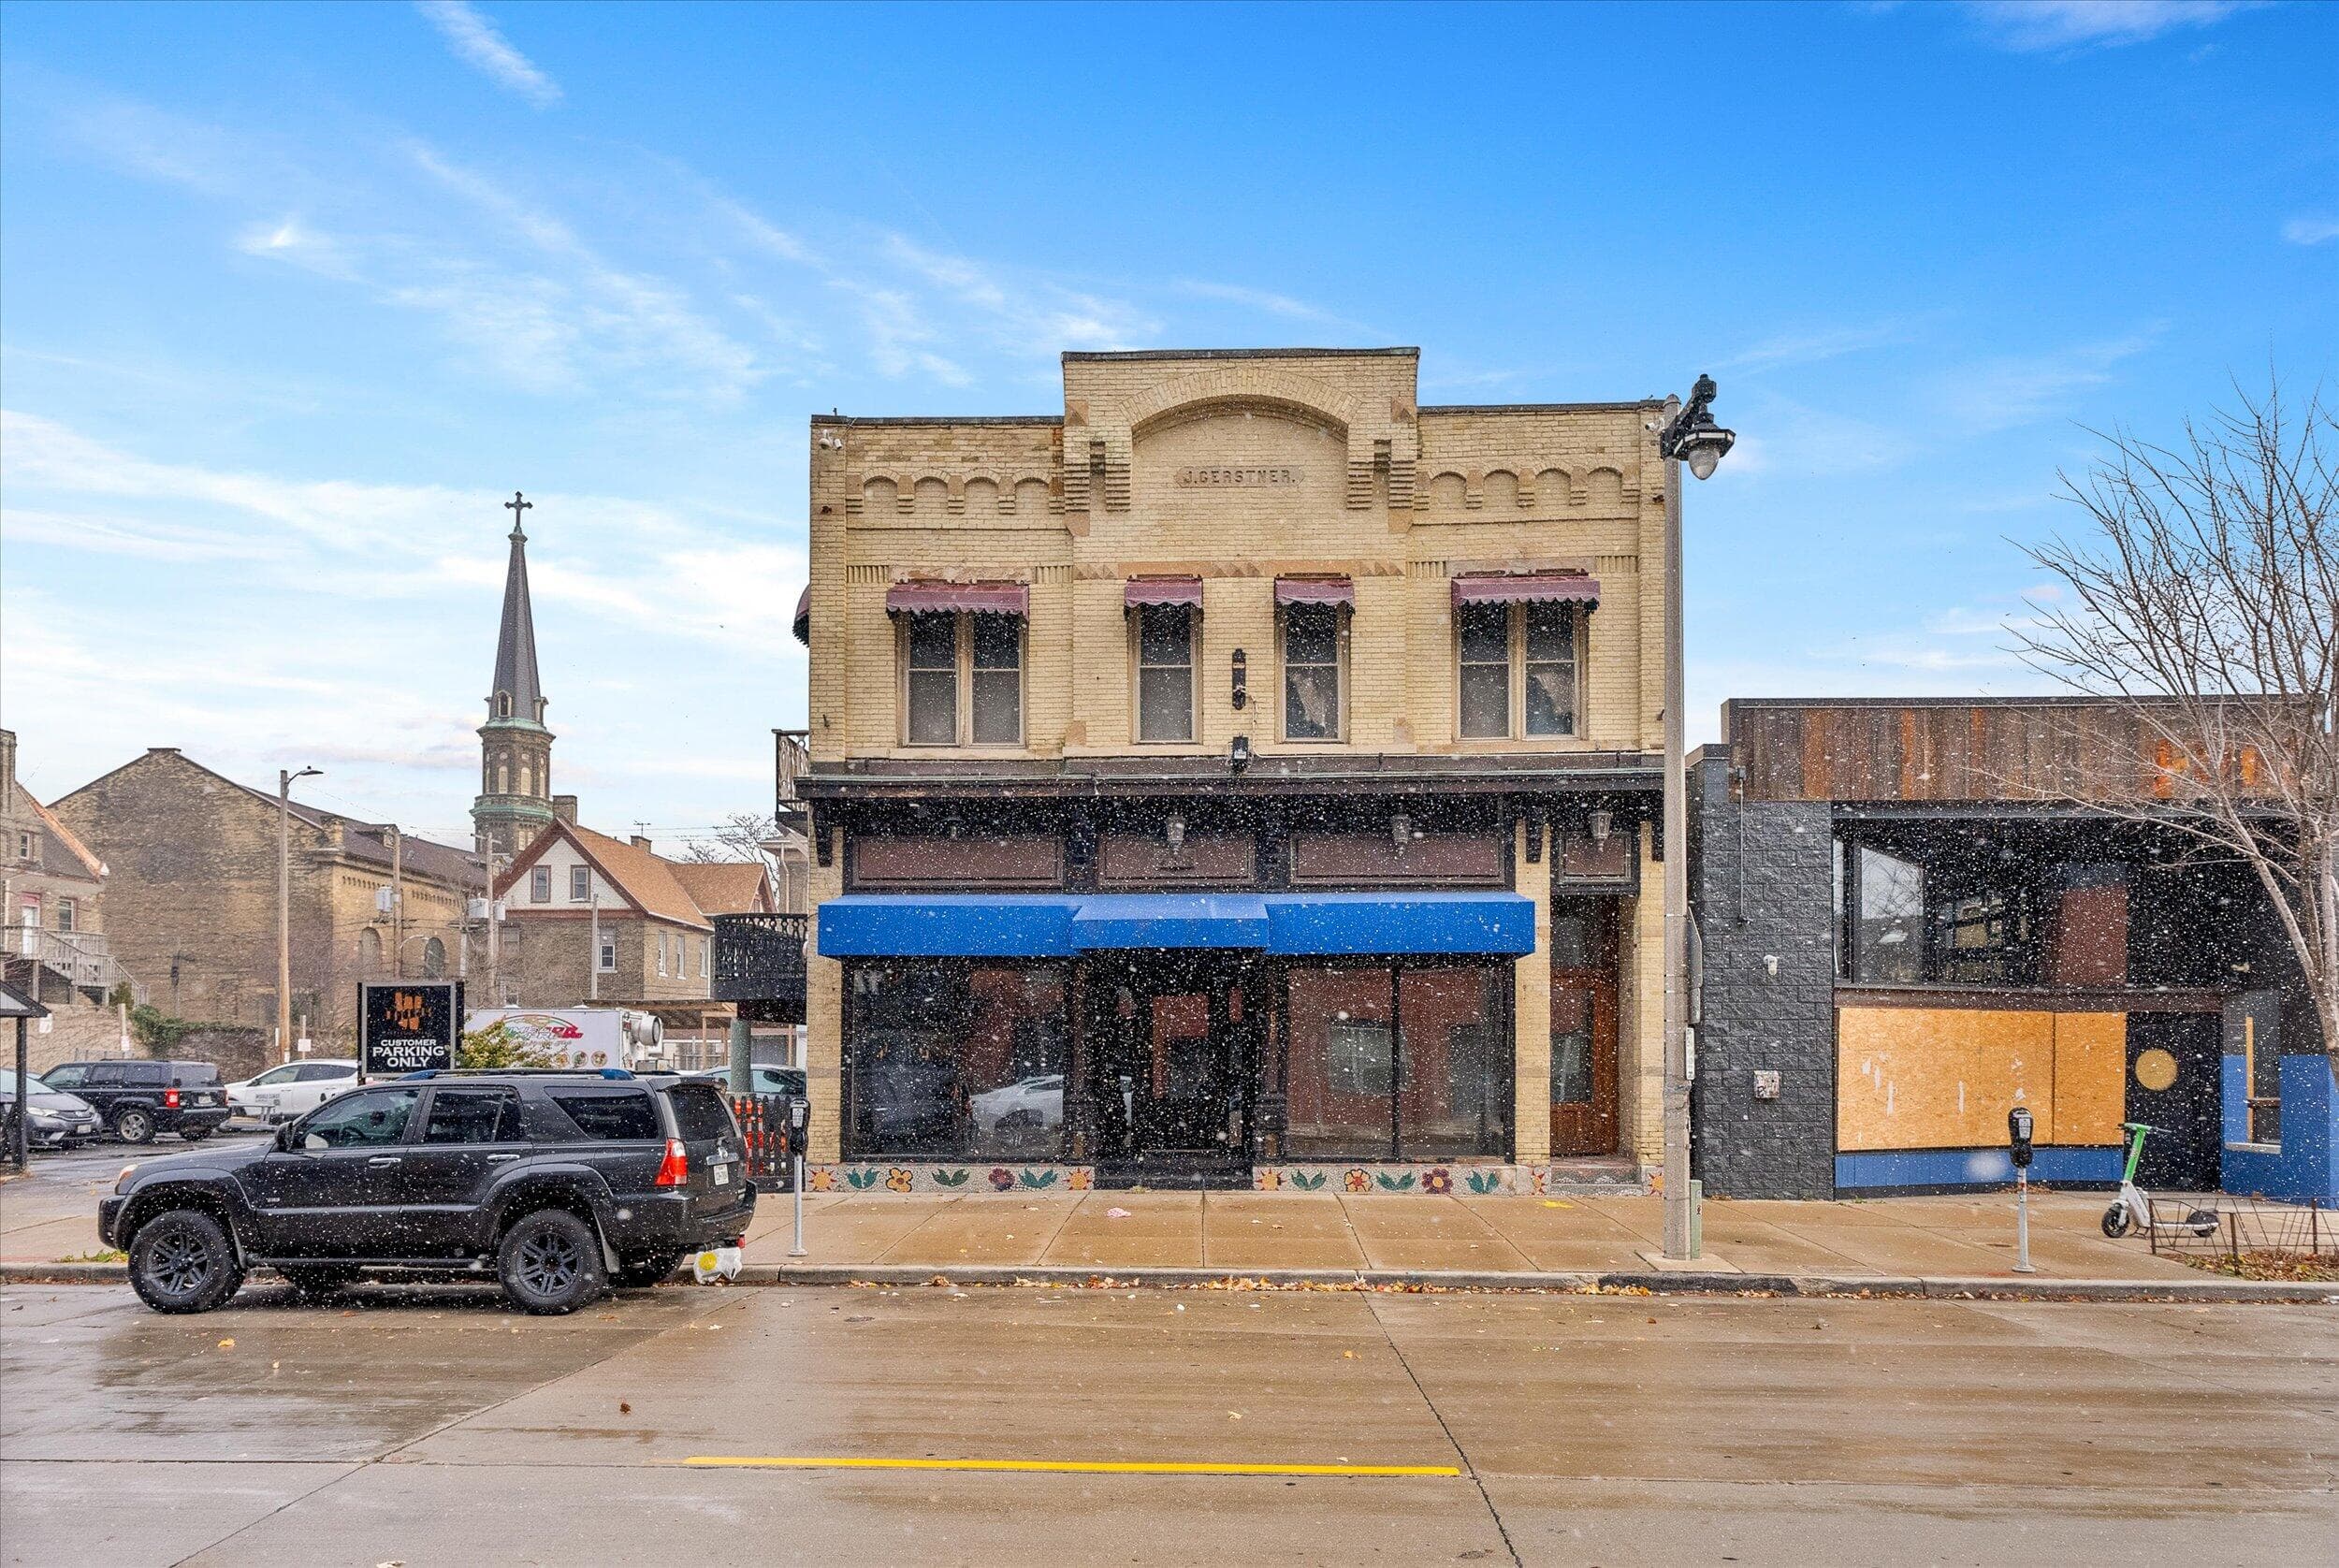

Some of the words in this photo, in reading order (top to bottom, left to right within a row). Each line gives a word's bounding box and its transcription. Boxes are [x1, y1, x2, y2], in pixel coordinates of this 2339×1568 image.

[380, 1038, 437, 1047] CUSTOMER
[372, 1046, 445, 1057] PARKING
[386, 1056, 430, 1067] ONLY
